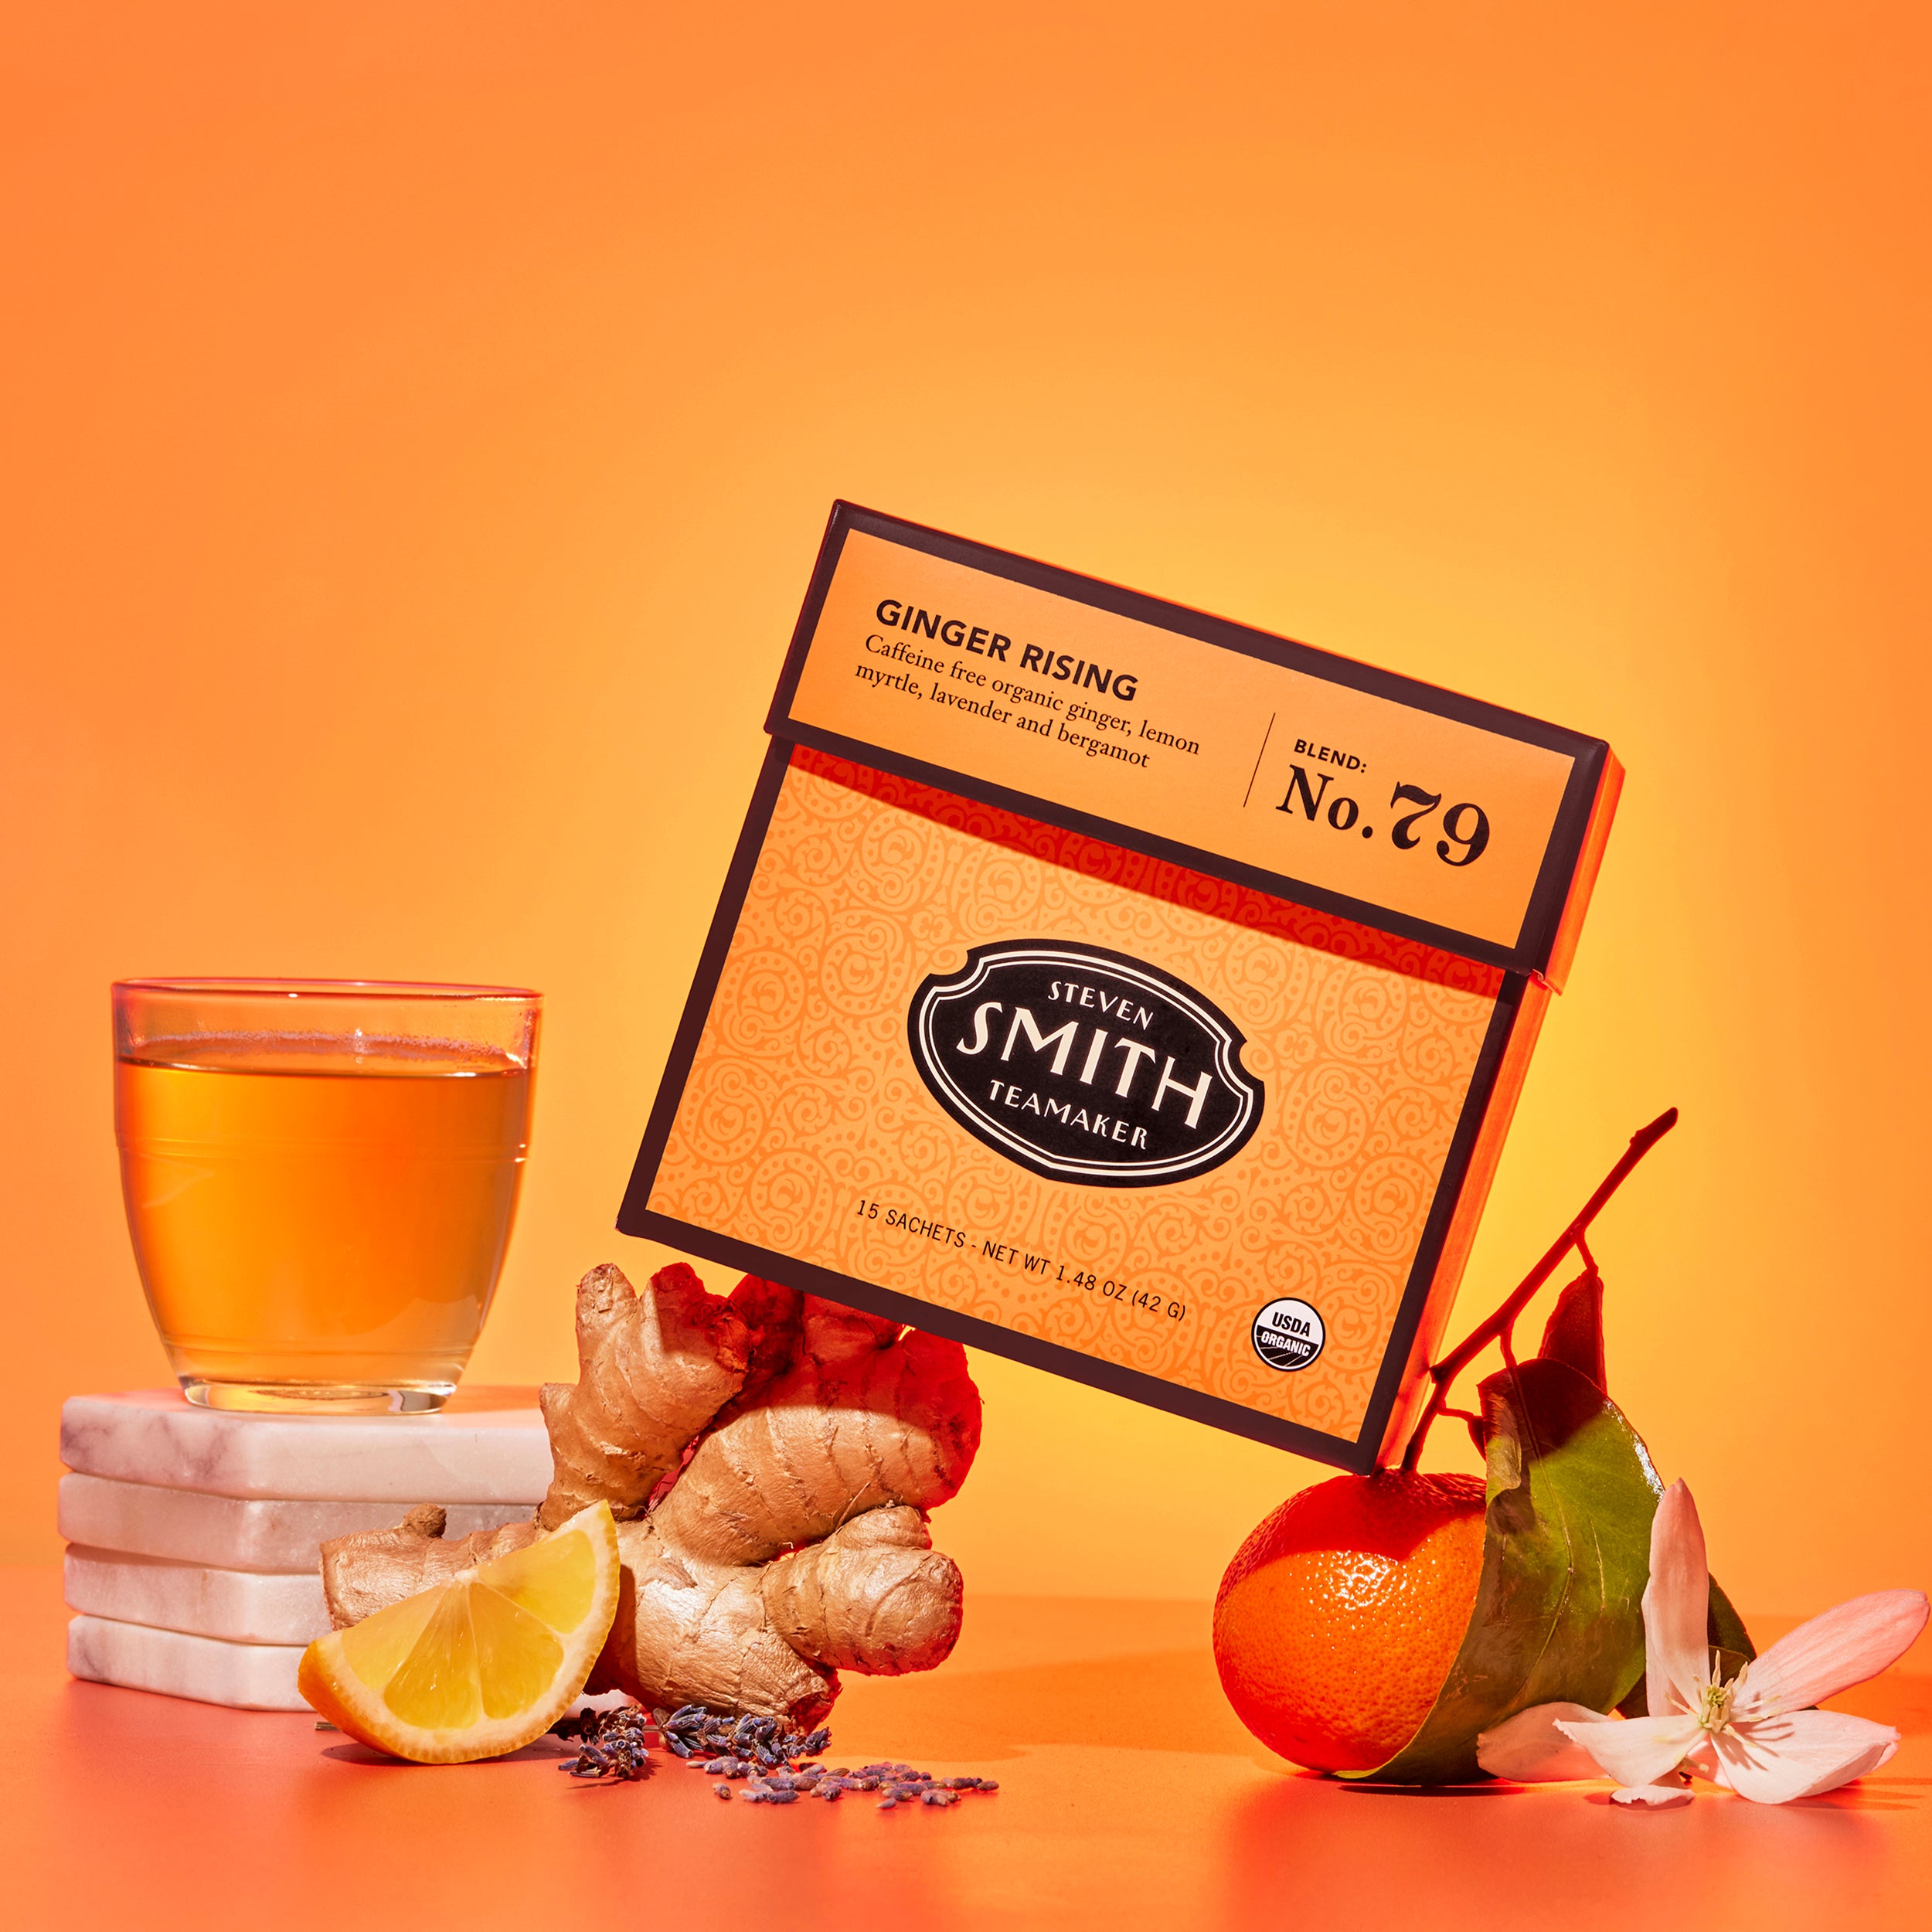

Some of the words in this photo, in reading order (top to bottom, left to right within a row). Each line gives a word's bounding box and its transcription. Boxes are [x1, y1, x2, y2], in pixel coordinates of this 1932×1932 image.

[876, 599, 1012, 662] GINGER
[1020, 644, 1138, 701] RISING
[855, 663, 923, 699] myrtle,
[930, 684, 1012, 723] lavender
[1016, 713, 1053, 736] and
[1057, 723, 1151, 767] bergamot
[865, 634, 944, 672] Caffeine
[951, 662, 987, 687] free
[992, 678, 1063, 710] organic
[1067, 702, 1132, 736] ginger,
[1138, 720, 1201, 755] lemon
[1293, 739, 1367, 774] BLEND:
[1048, 981, 1154, 1030] STEVEN
[956, 1002, 1213, 1129] SMITH
[989, 1079, 1148, 1150] TEAMAKER
[857, 1200, 879, 1219] 15
[885, 1209, 966, 1248] SACHETS
[982, 1240, 1019, 1264] NET
[1024, 1253, 1050, 1275] WT
[1056, 1265, 1095, 1291] 1.48
[1103, 1281, 1128, 1301] OZ
[1131, 1290, 1162, 1311] (42
[1167, 1301, 1186, 1321] G)
[1261, 1331, 1311, 1356] ORGANIC
[1272, 1311, 1310, 1337] USDA
